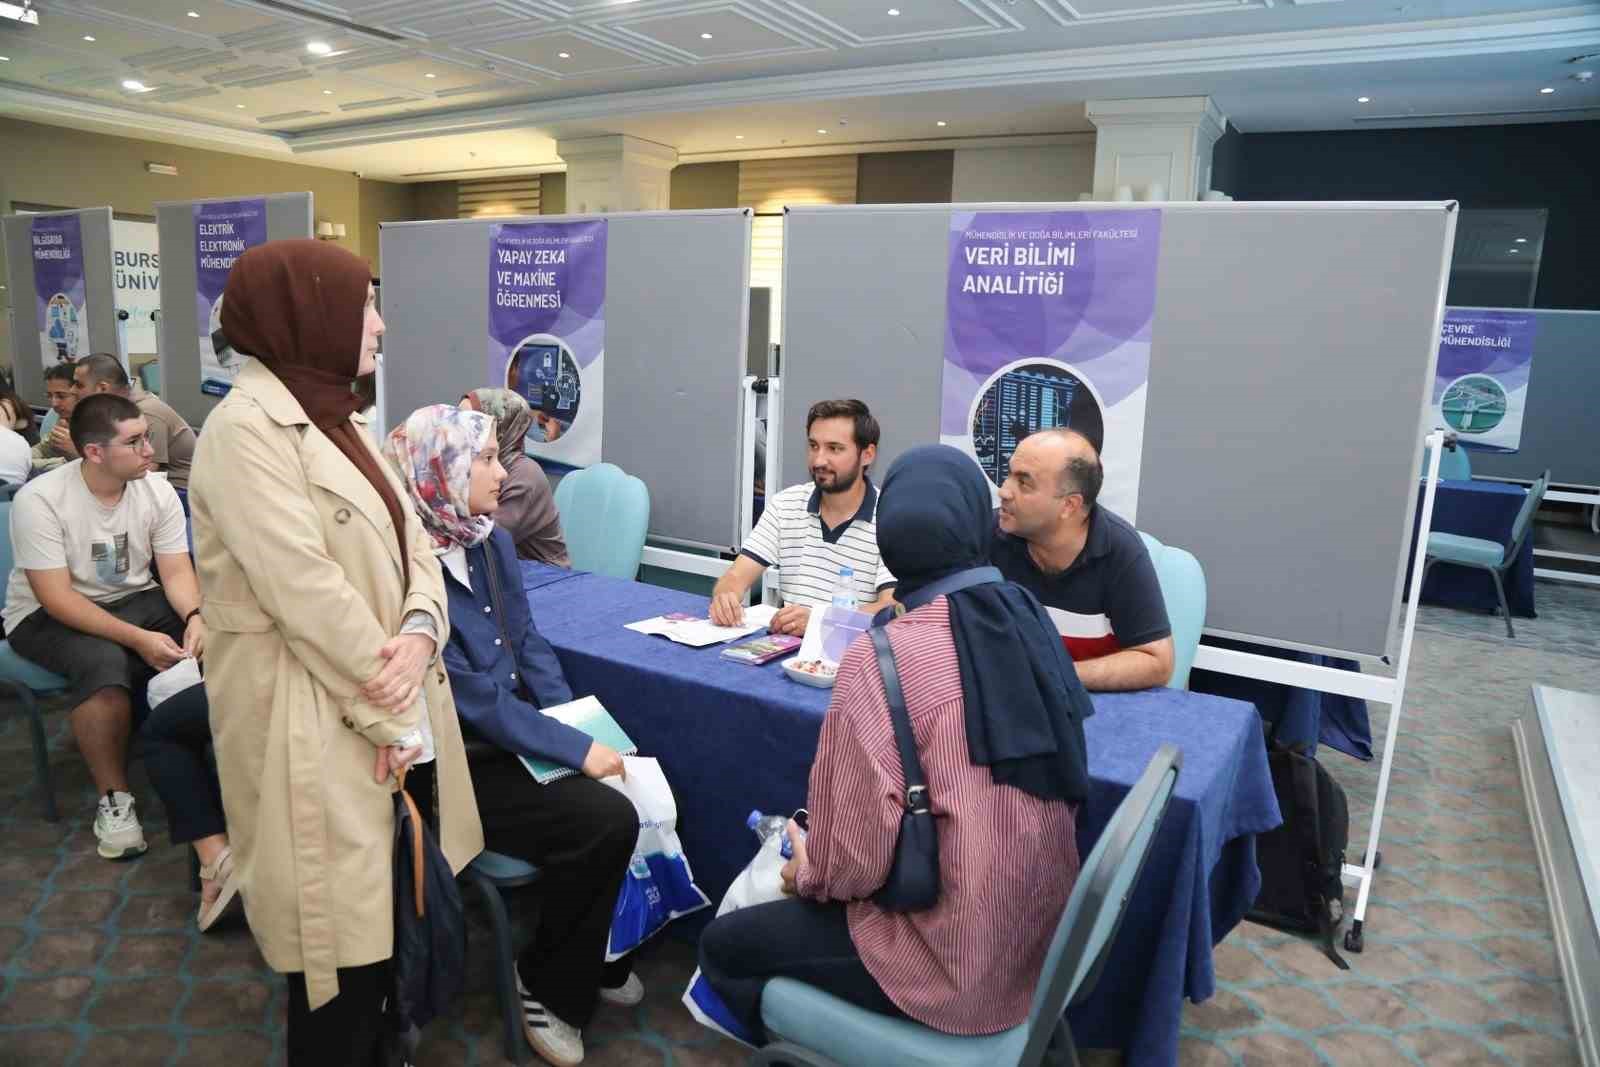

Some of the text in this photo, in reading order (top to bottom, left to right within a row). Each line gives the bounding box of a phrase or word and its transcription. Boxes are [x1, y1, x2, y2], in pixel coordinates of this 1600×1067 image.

[199, 220, 235, 236] ELEKTRİK
[200, 237, 246, 252] ELEKTRONİK
[114, 251, 160, 269] BURS
[497, 249, 566, 265] YAPAY ZEKA
[965, 242, 1076, 267] VERİ BİLİMİ
[116, 269, 160, 291] ÜNİV
[497, 268, 557, 287] VE MAKİNE
[962, 271, 1065, 295] ANALİTİĞİ
[496, 288, 561, 309] ÖĞRENMESİ
